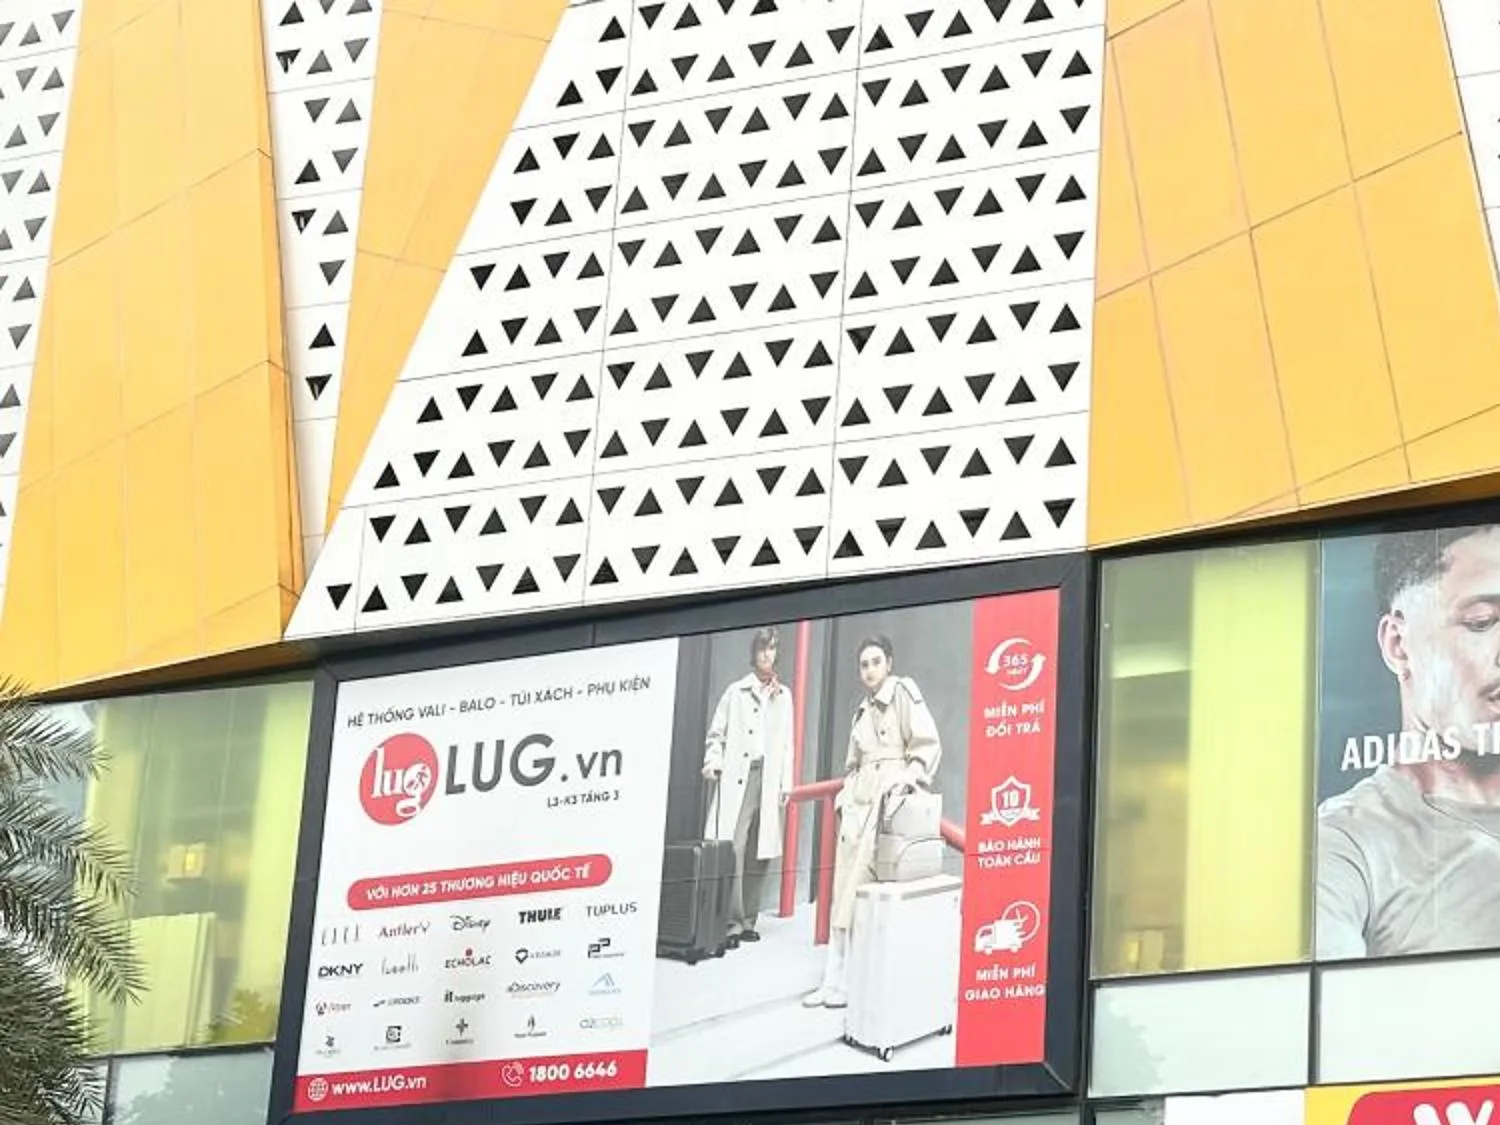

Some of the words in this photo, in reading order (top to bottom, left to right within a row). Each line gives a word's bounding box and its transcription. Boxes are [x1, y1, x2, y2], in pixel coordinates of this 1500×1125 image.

[1341, 733, 1462, 772] ADIDAS
[444, 733, 623, 796] LUG.vn
[370, 747, 433, 818] lug
[518, 906, 563, 925] THULE
[317, 962, 364, 979] DKNY
[964, 986, 1001, 1001] GIAO
[528, 1062, 570, 1082] 1800
[331, 1073, 428, 1096] www.LUG.vn
